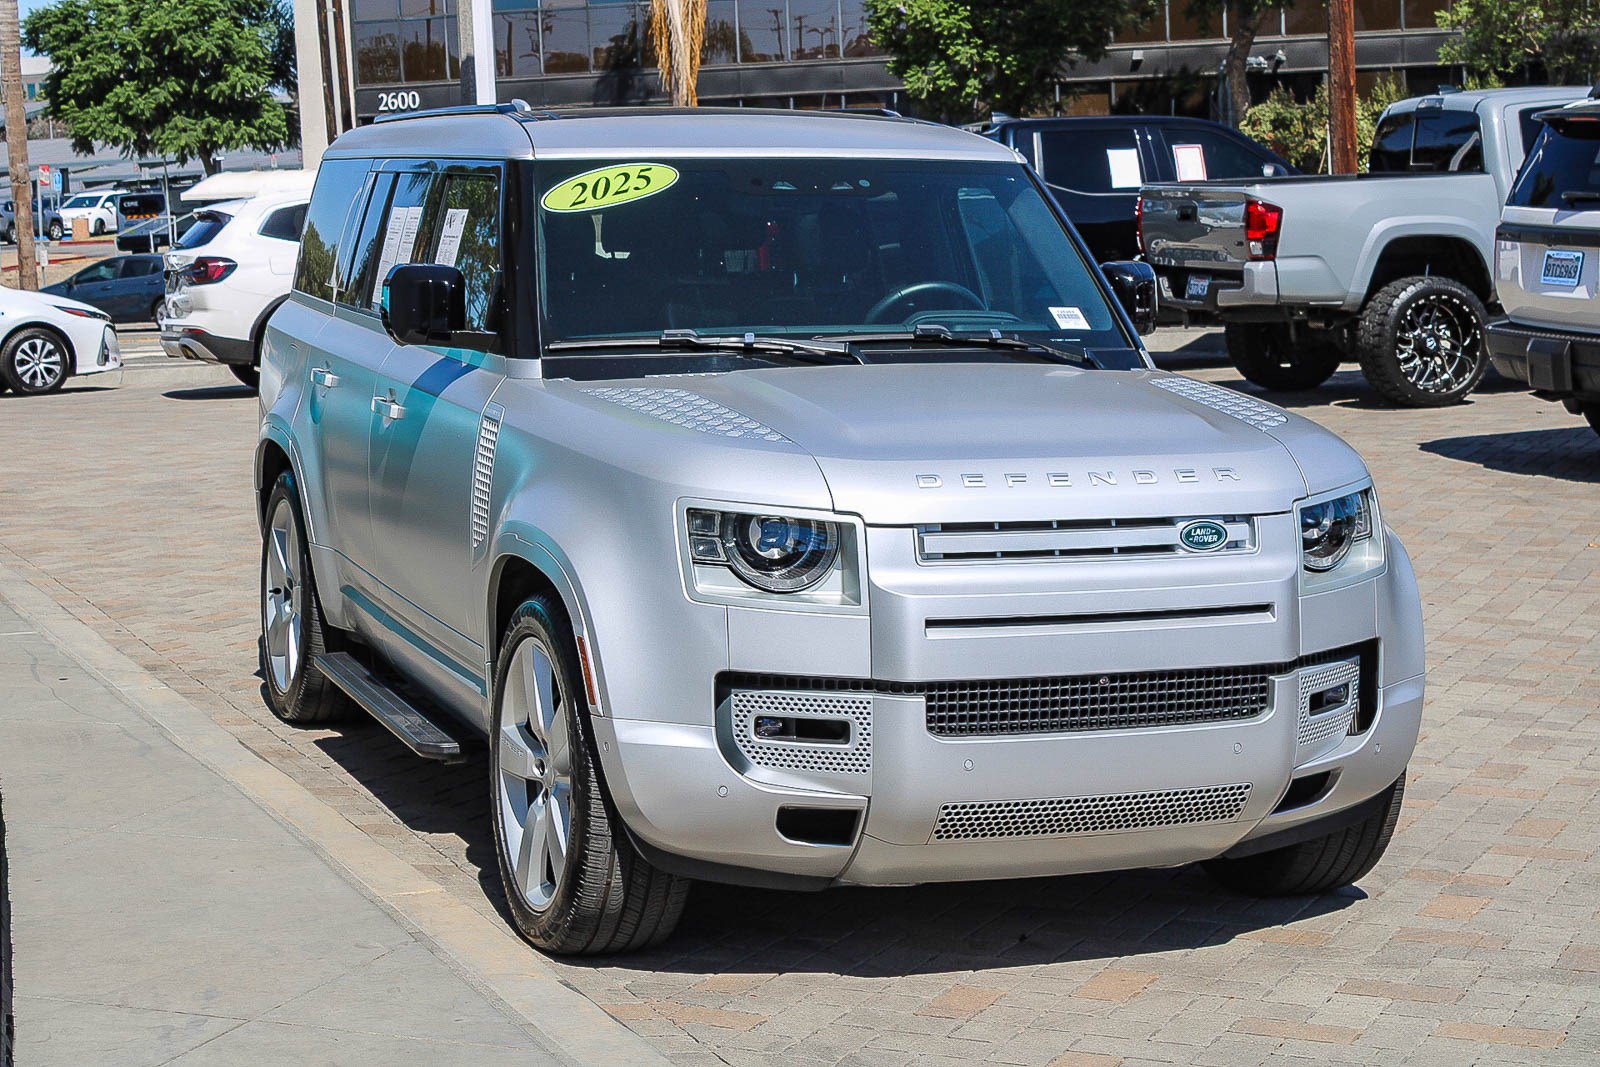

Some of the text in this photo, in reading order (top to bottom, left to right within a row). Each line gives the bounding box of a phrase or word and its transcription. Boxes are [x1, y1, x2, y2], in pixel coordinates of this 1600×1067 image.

[378, 90, 420, 111] 2600
[569, 167, 653, 208] 2025
[915, 466, 1241, 488] DEFENDER
